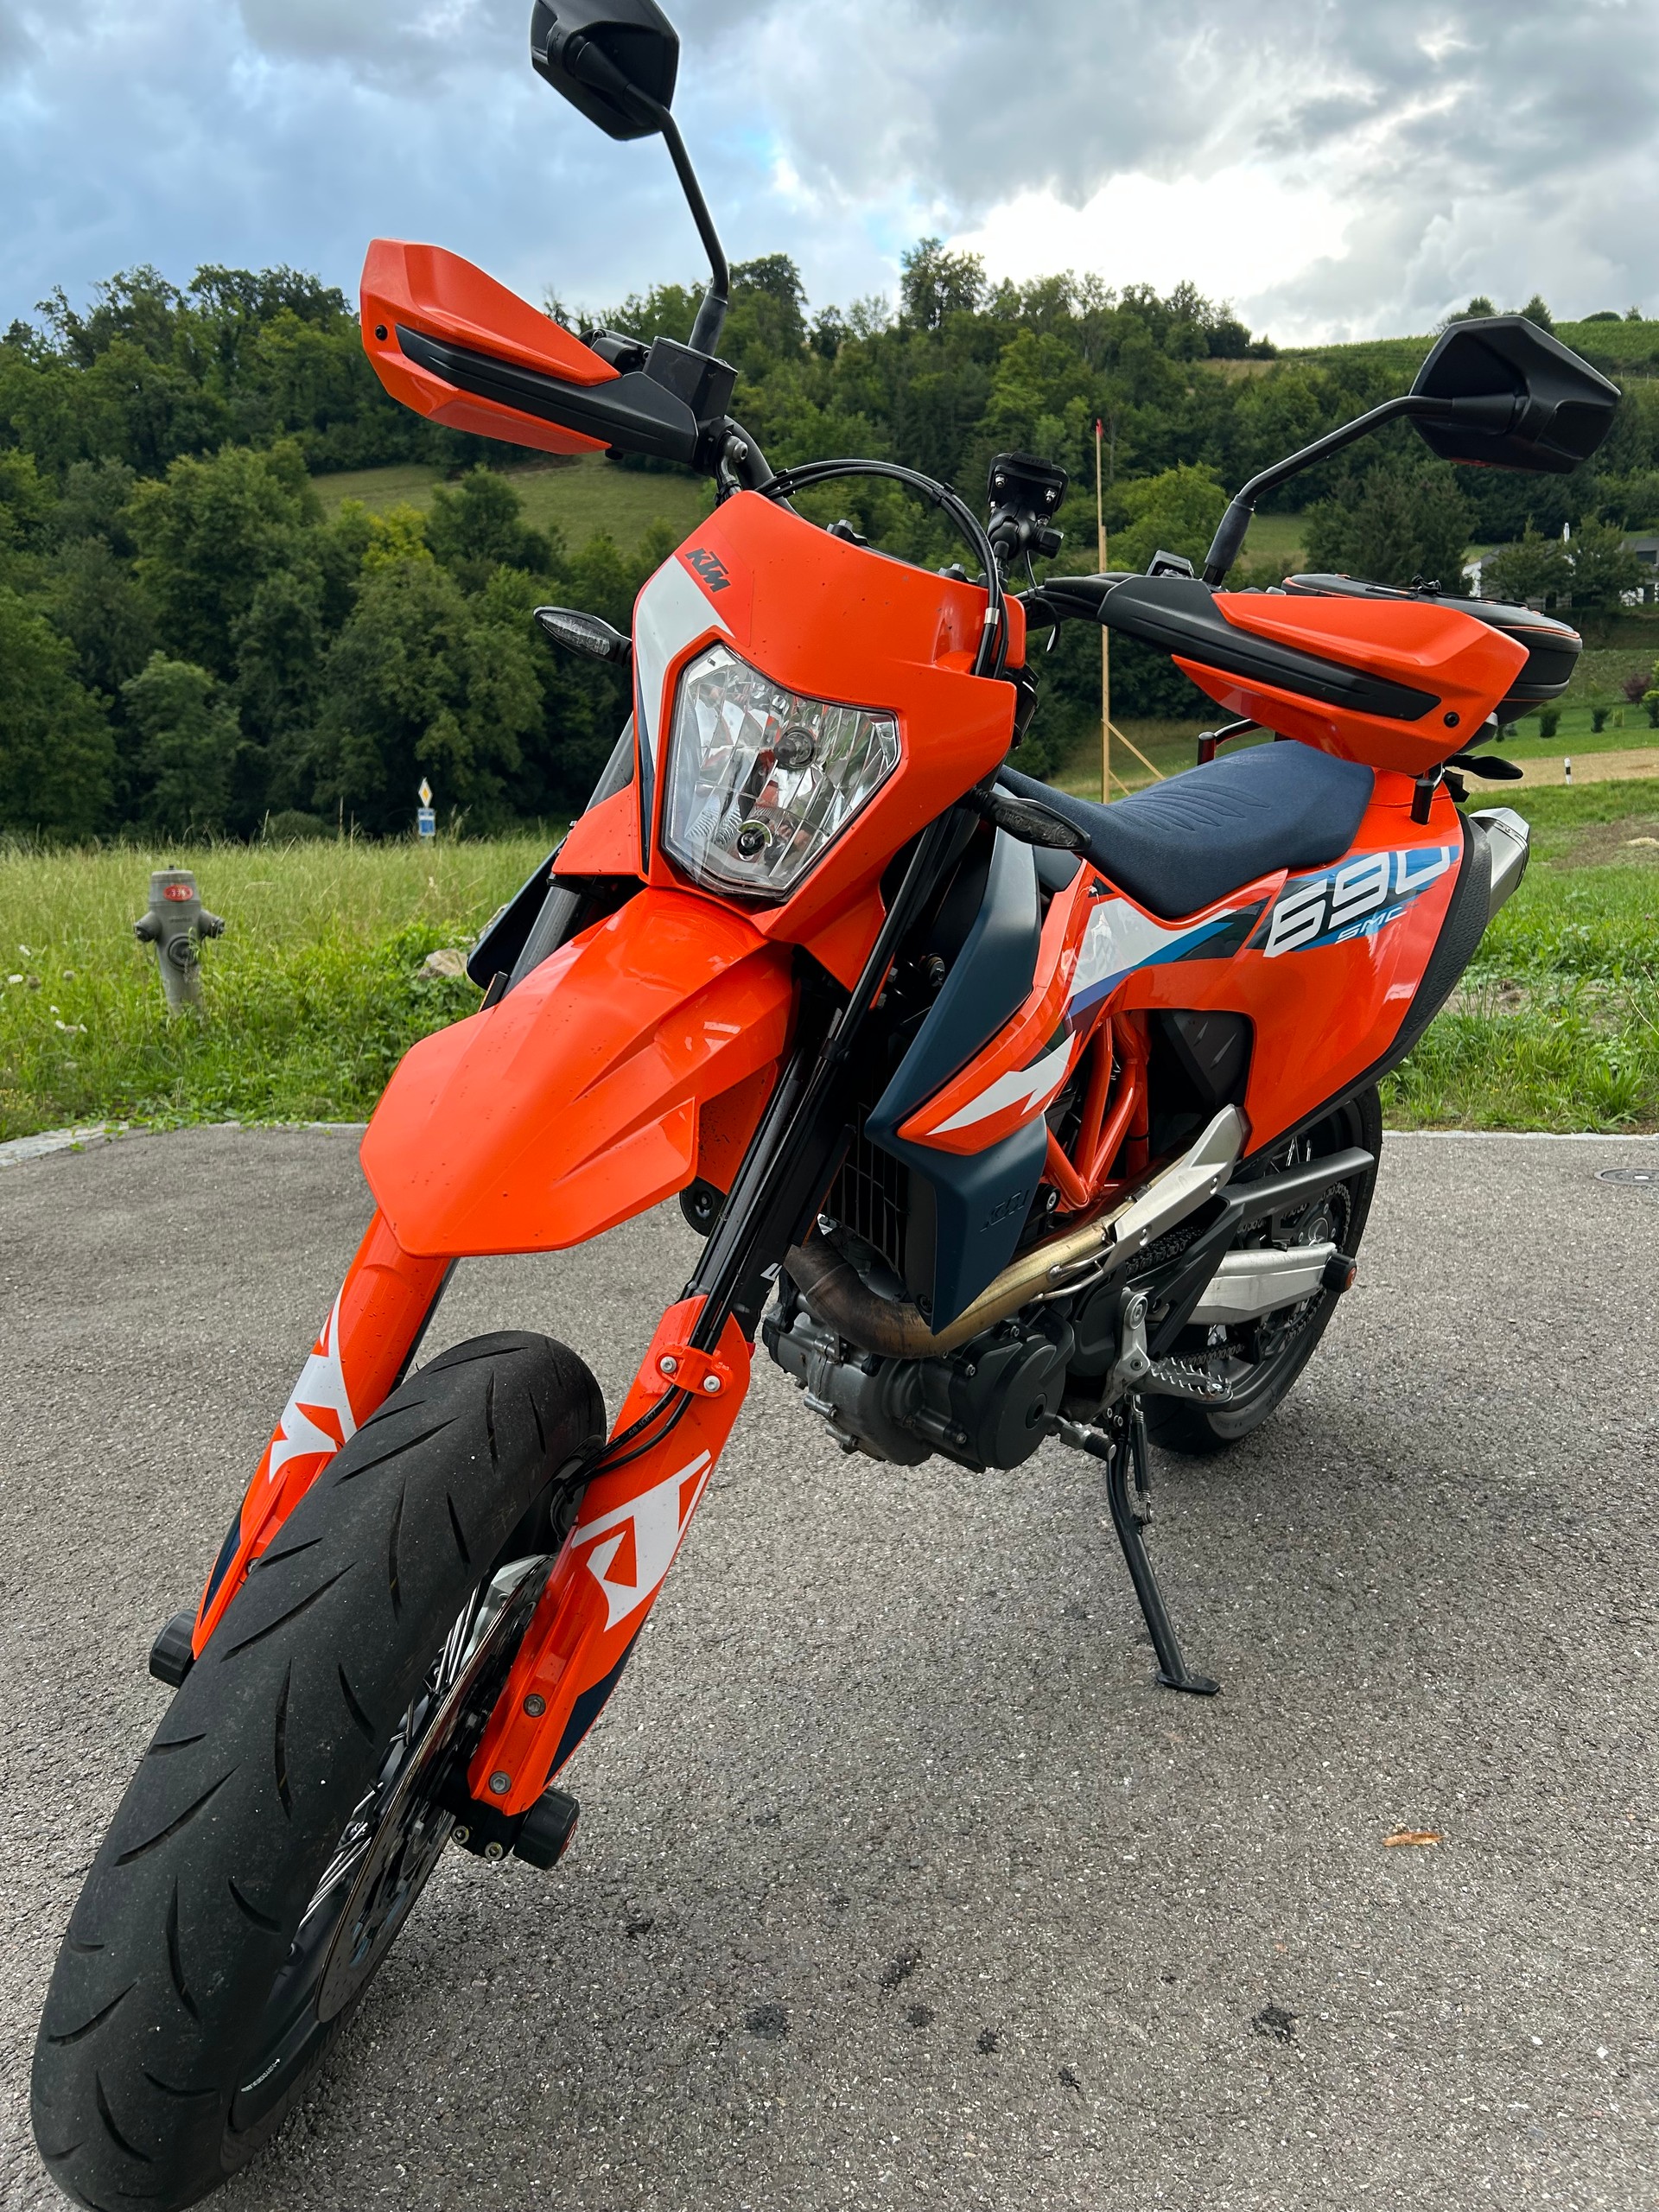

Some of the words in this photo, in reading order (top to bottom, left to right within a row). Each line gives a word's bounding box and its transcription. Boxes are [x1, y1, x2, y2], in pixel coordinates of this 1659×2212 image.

[685, 548, 731, 593] KTM
[1262, 846, 1451, 958] 690
[1334, 907, 1408, 944] SMC
